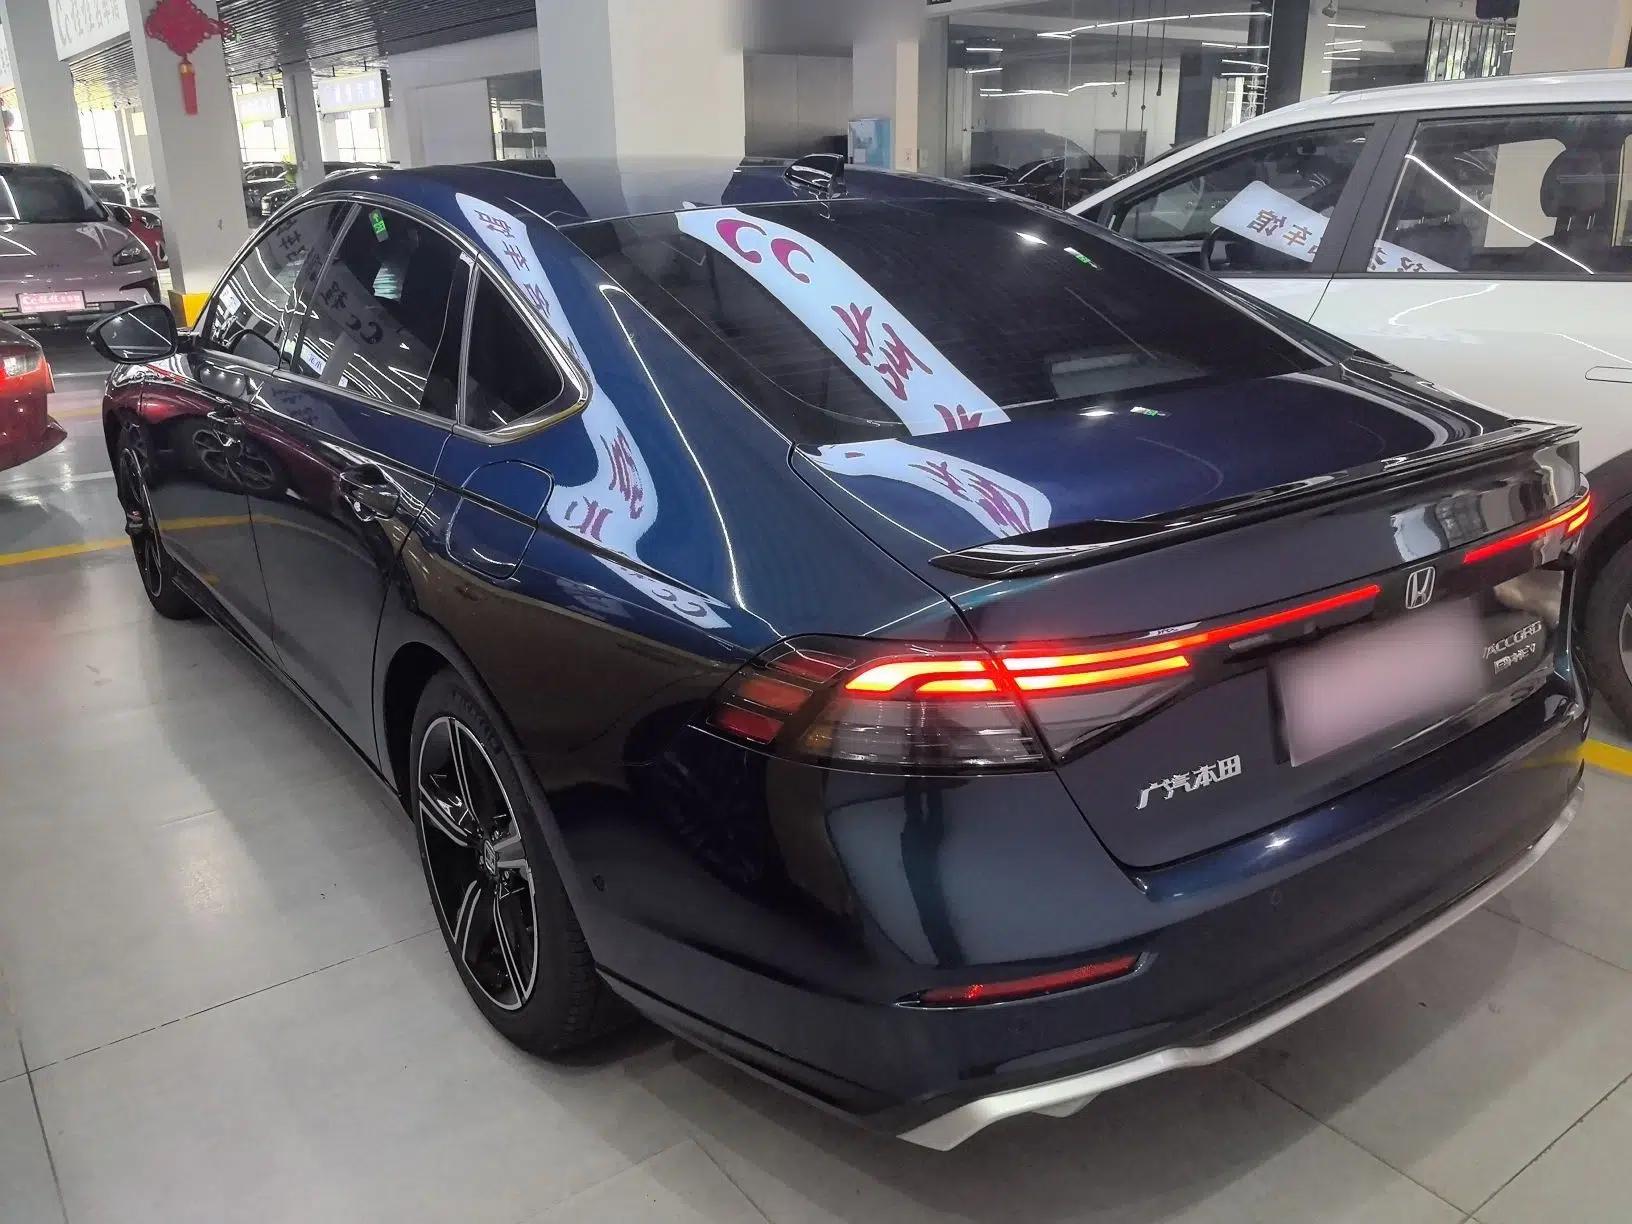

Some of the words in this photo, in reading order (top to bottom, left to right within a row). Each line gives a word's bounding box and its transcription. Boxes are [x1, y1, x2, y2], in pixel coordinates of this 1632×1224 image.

[1482, 620, 1542, 660] ACCORD
[1136, 754, 1242, 810] 广汽本田
